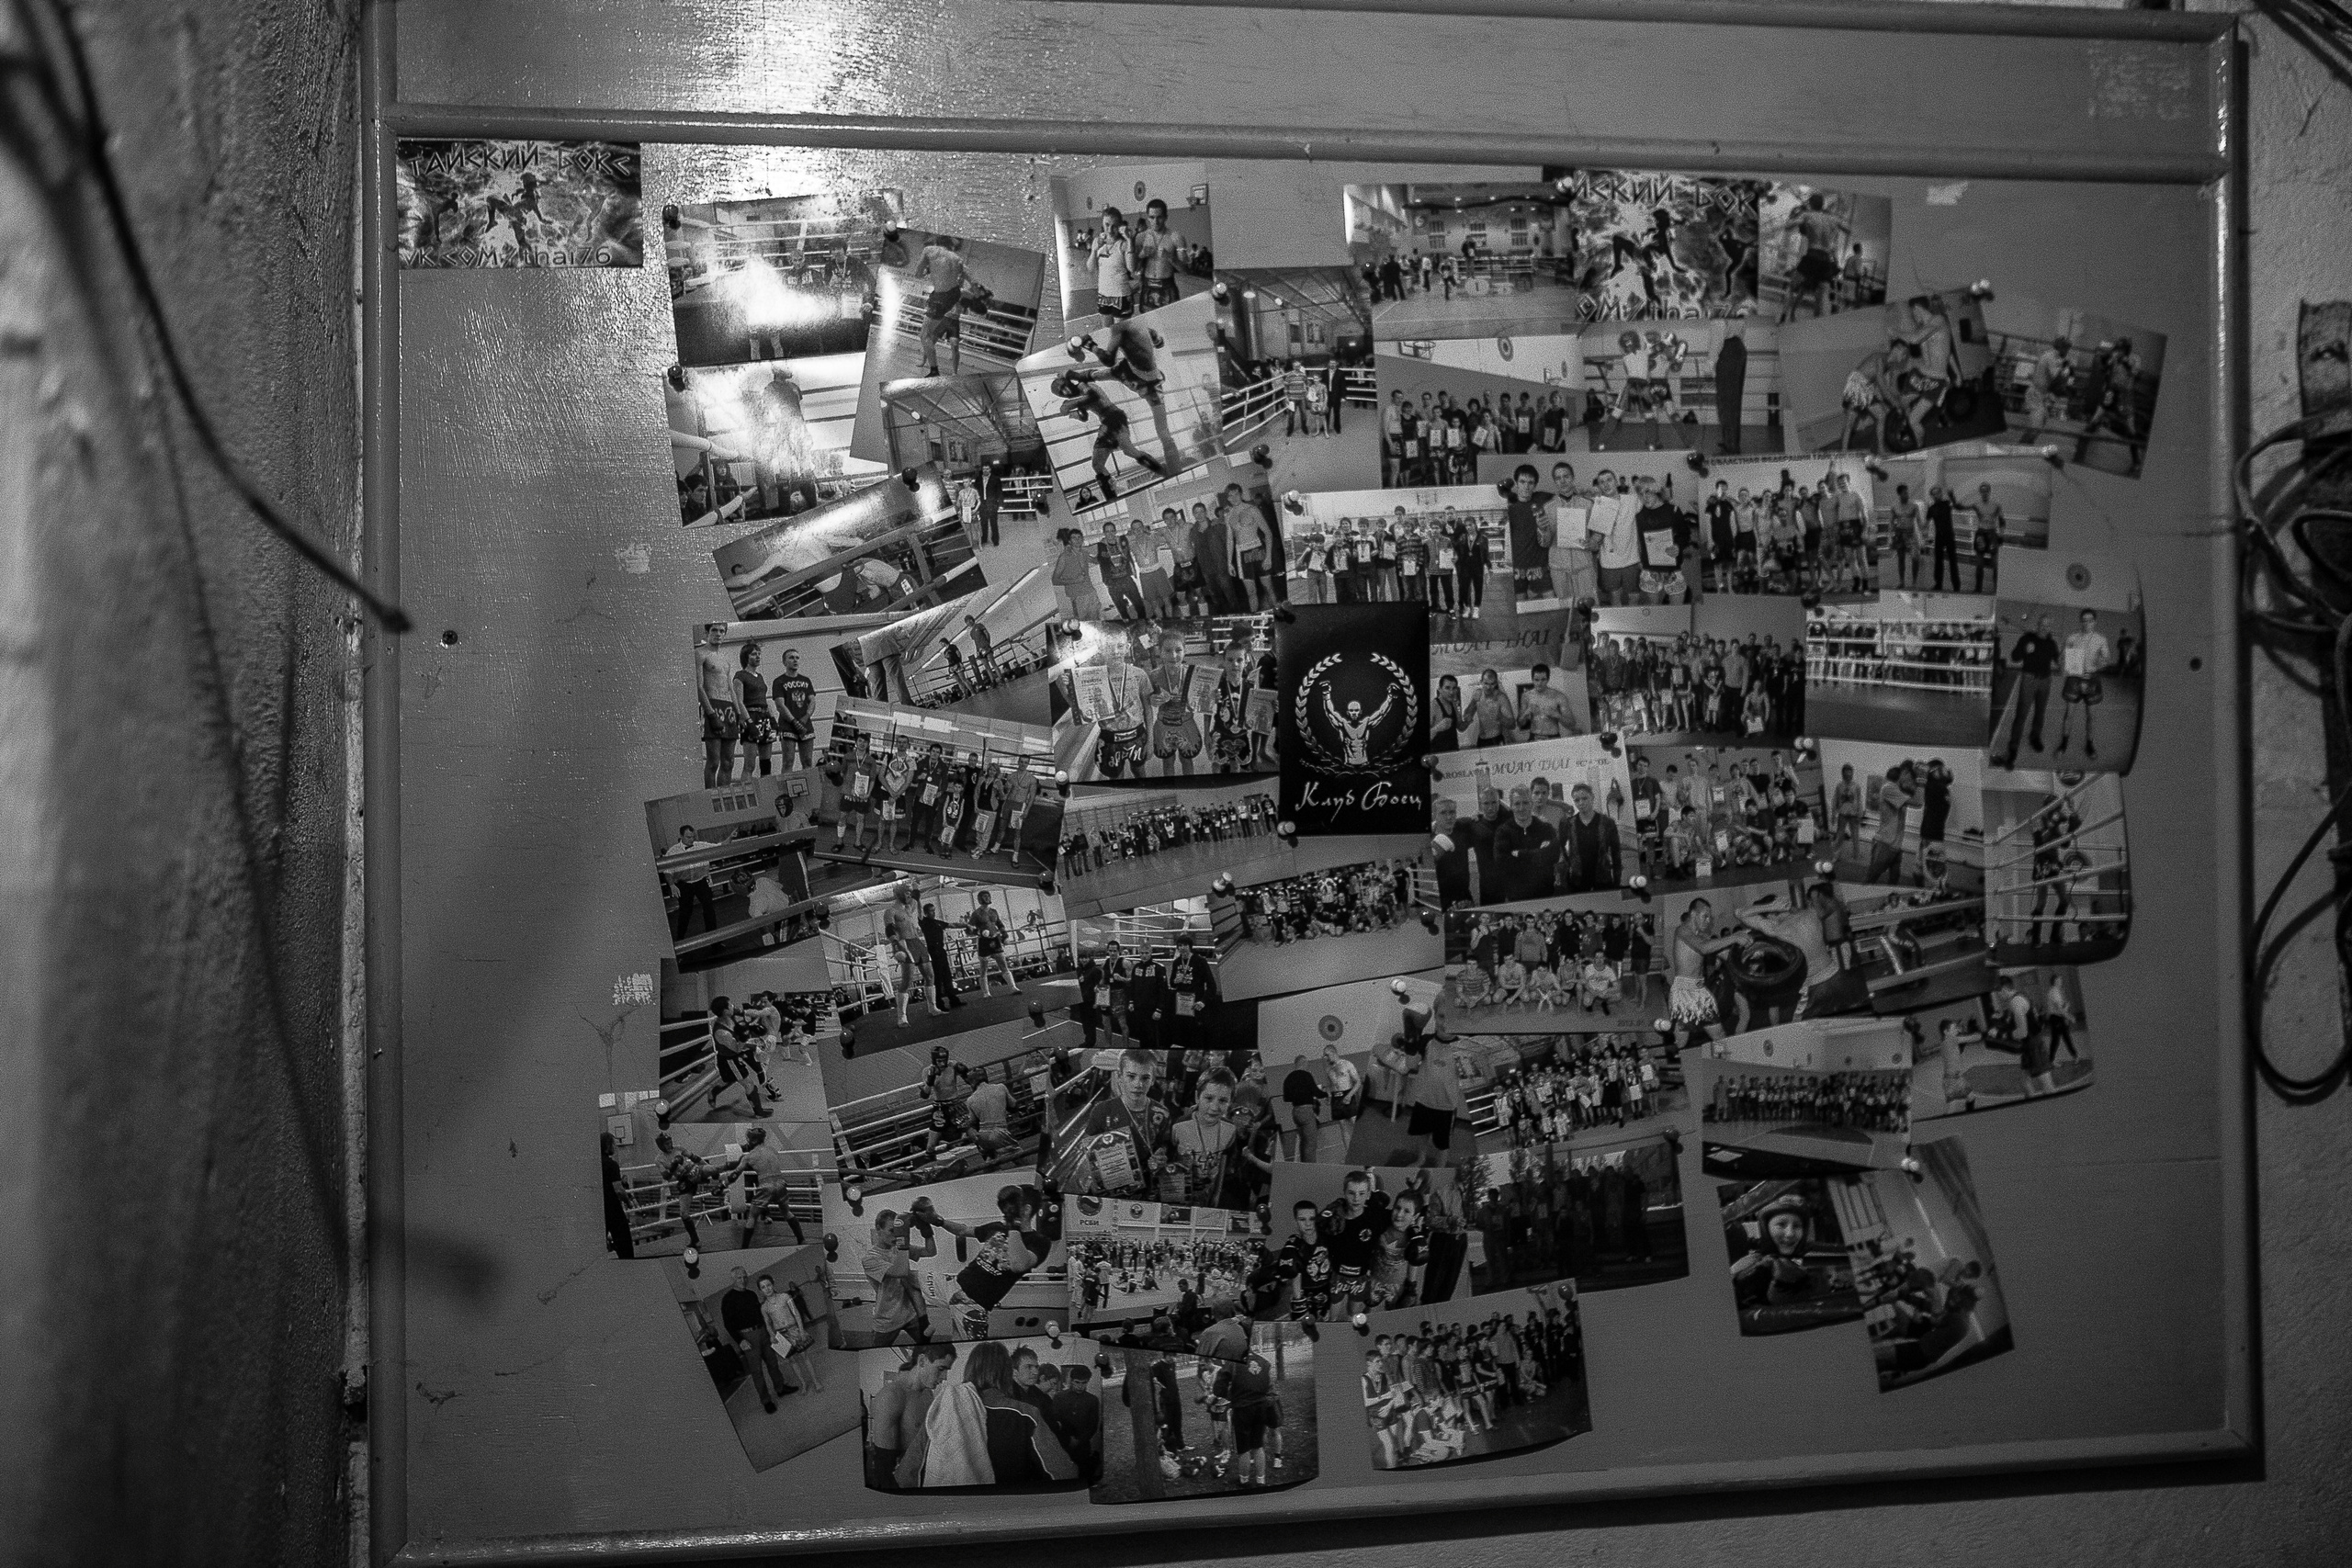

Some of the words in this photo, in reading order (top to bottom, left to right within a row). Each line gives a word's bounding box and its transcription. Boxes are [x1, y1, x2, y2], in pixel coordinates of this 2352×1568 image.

[557, 146, 631, 177] БОКС
[1492, 761, 1535, 775] MUAY
[1295, 781, 1355, 823] Клуб
[1361, 780, 1422, 811] Боец
